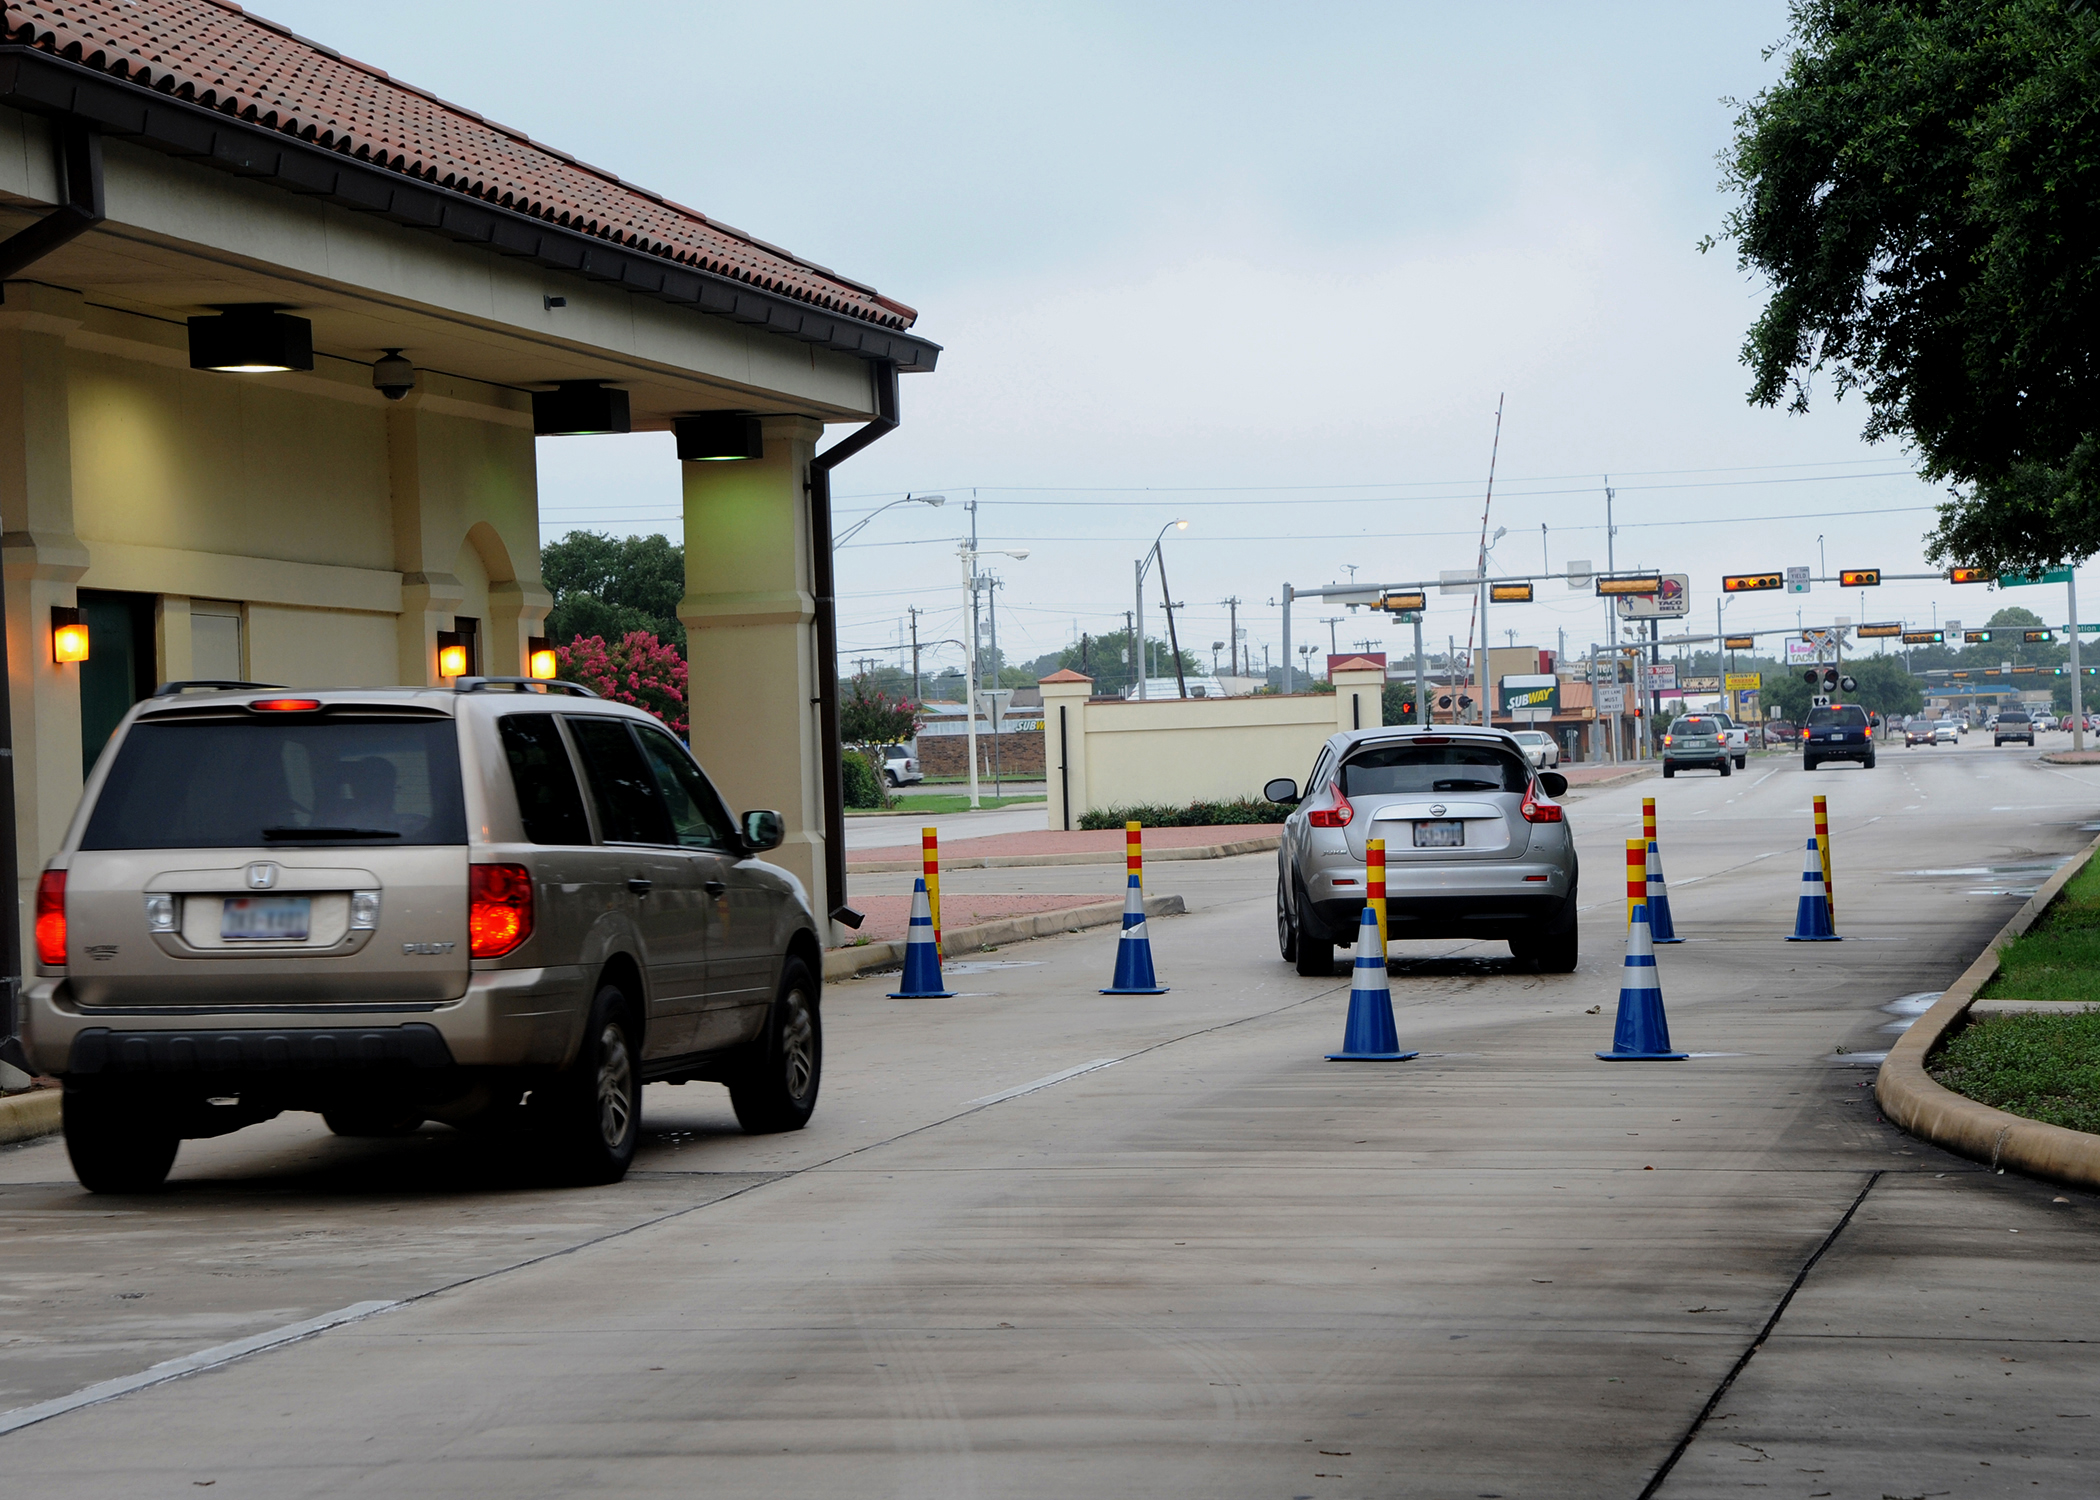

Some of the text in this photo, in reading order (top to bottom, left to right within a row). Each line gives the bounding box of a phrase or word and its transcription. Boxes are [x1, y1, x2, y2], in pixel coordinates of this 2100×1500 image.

[1507, 687, 1554, 710] SUBWAY
[1015, 720, 1046, 731] SUBW
[402, 942, 456, 956] PILOT
